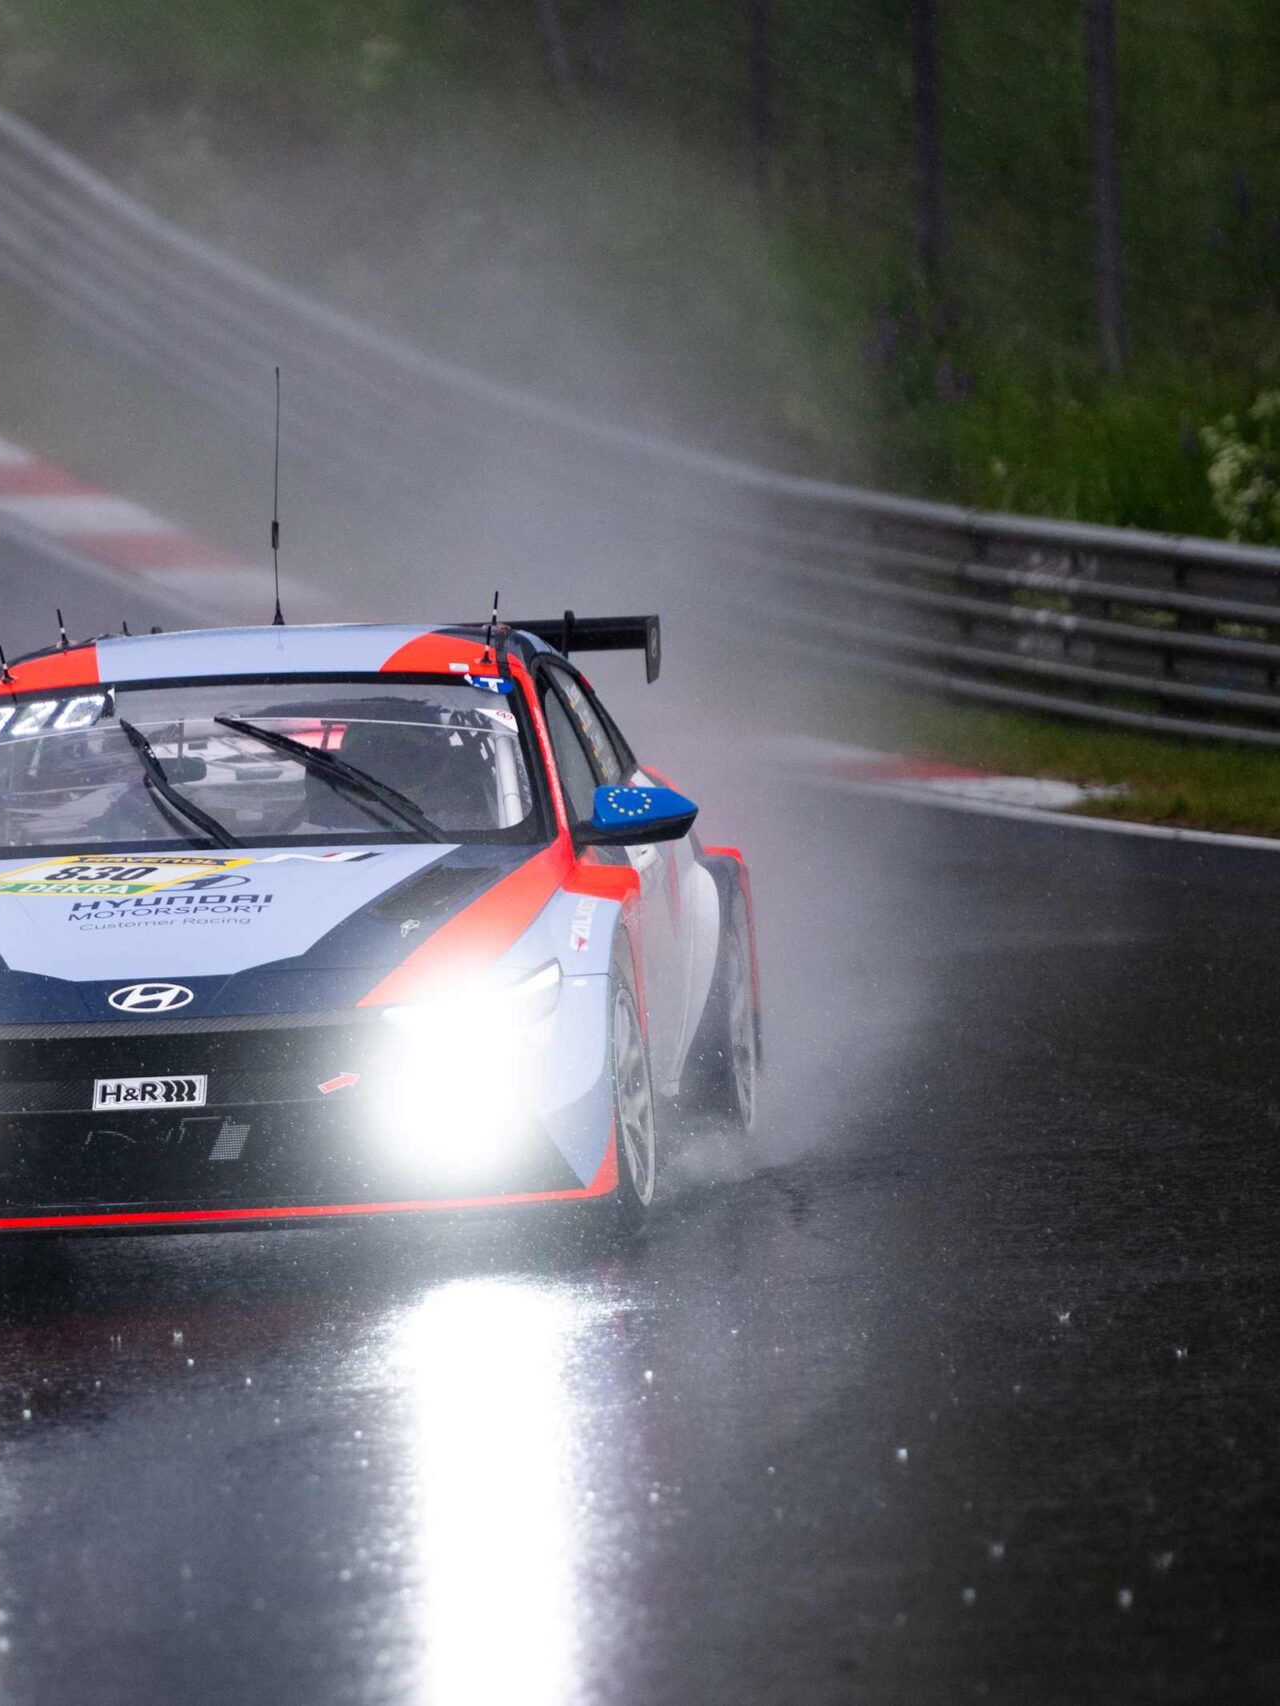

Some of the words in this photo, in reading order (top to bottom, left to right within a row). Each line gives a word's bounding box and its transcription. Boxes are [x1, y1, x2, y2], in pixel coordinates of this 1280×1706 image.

[45, 866, 158, 881] 830
[17, 884, 129, 894] DEKRA
[72, 894, 273, 911] HYUNDAI
[68, 905, 270, 921] MOTORSPORT
[80, 920, 176, 931] Customer
[182, 917, 252, 926] Racing
[101, 1083, 158, 1103] H&R
